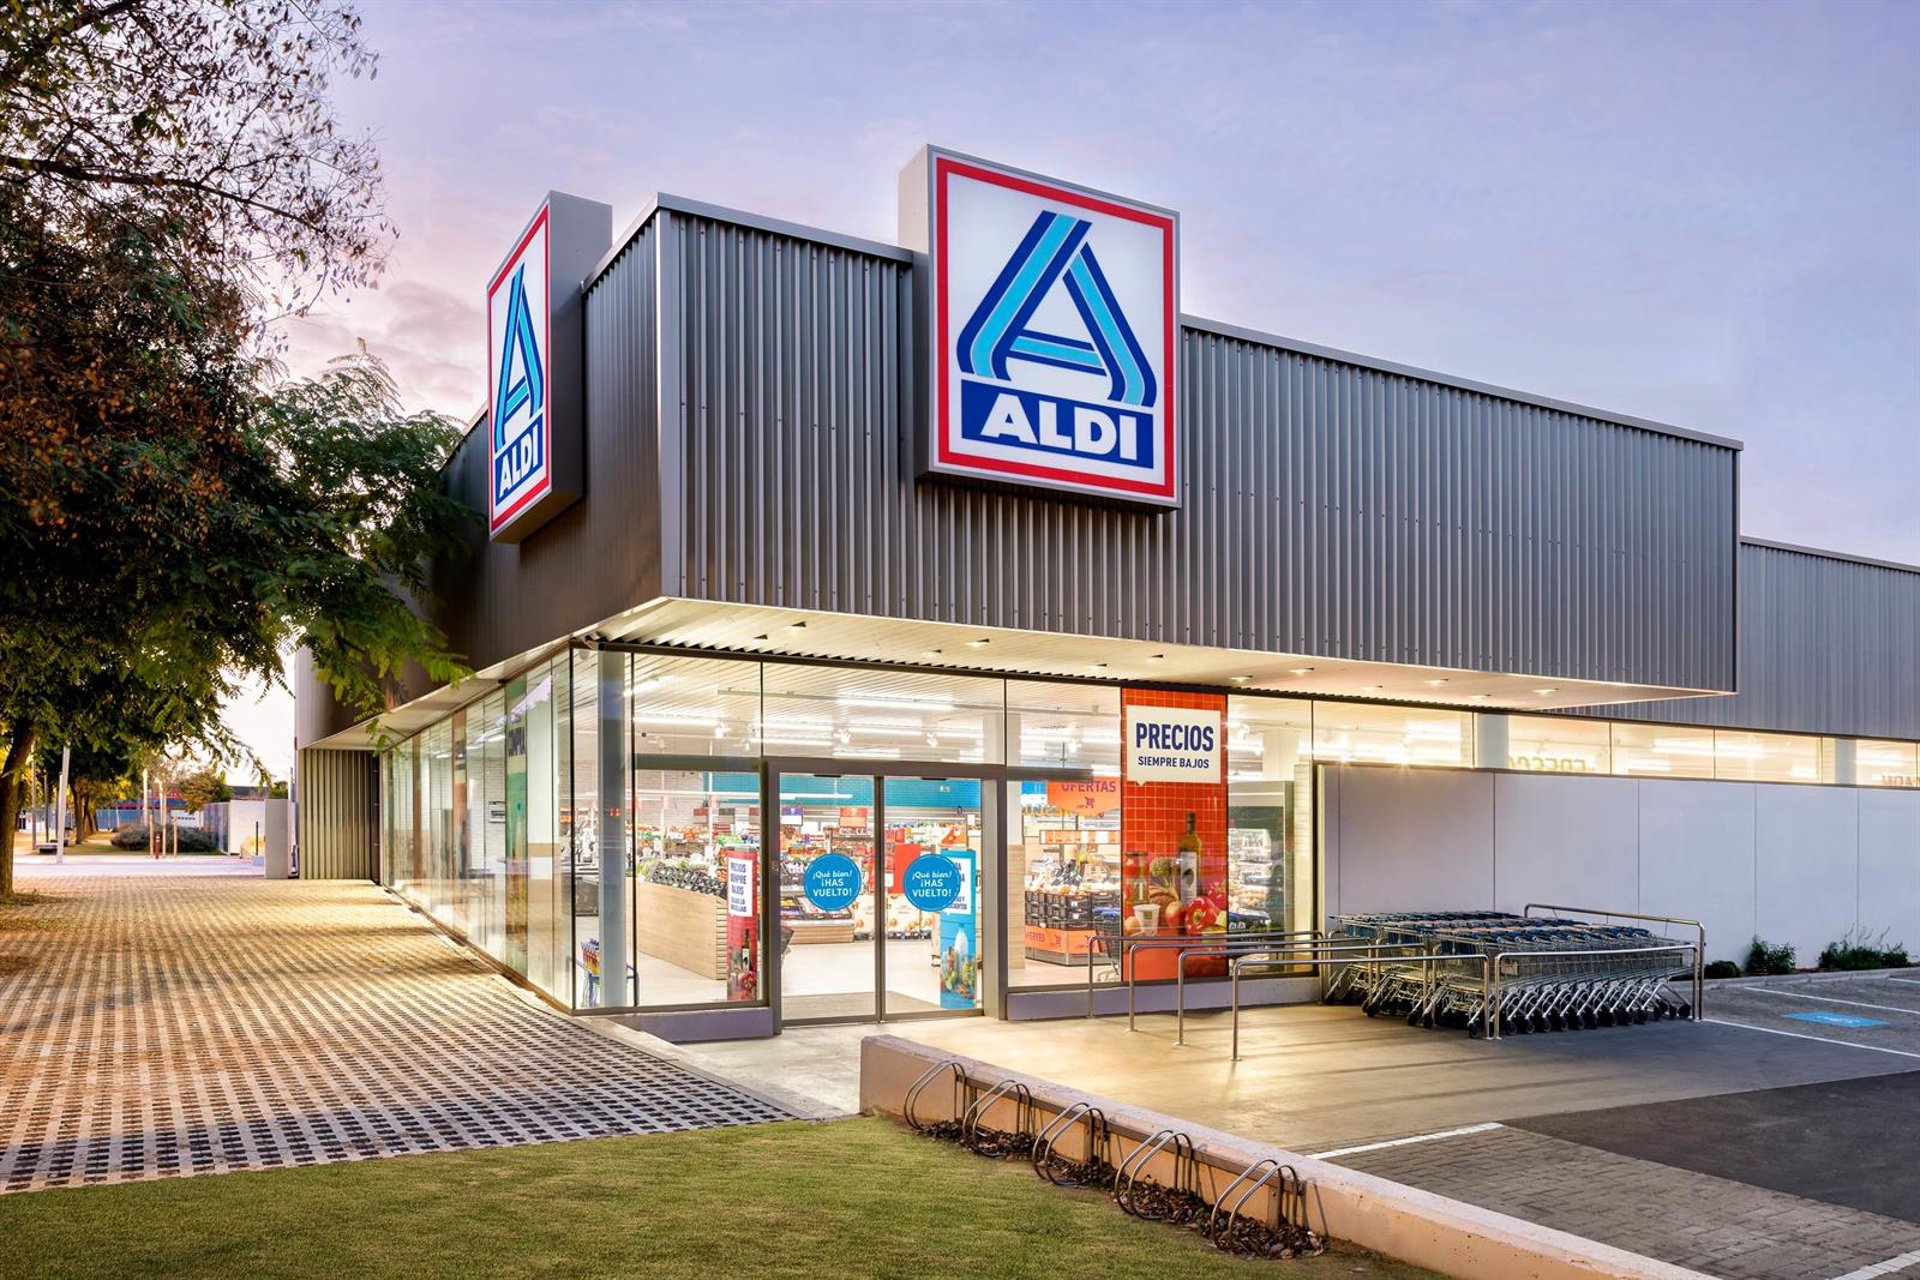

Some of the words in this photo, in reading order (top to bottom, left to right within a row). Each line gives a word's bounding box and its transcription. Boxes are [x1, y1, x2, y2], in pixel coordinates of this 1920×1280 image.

[980, 392, 1138, 461] ALDI
[499, 423, 539, 497] ALDI
[1136, 722, 1214, 752] PRECIOS
[1138, 756, 1178, 768] SIEMPRE
[1180, 757, 1209, 769] BAJOS
[812, 887, 853, 897] VUELTO!
[911, 888, 952, 897] VUELTO!
